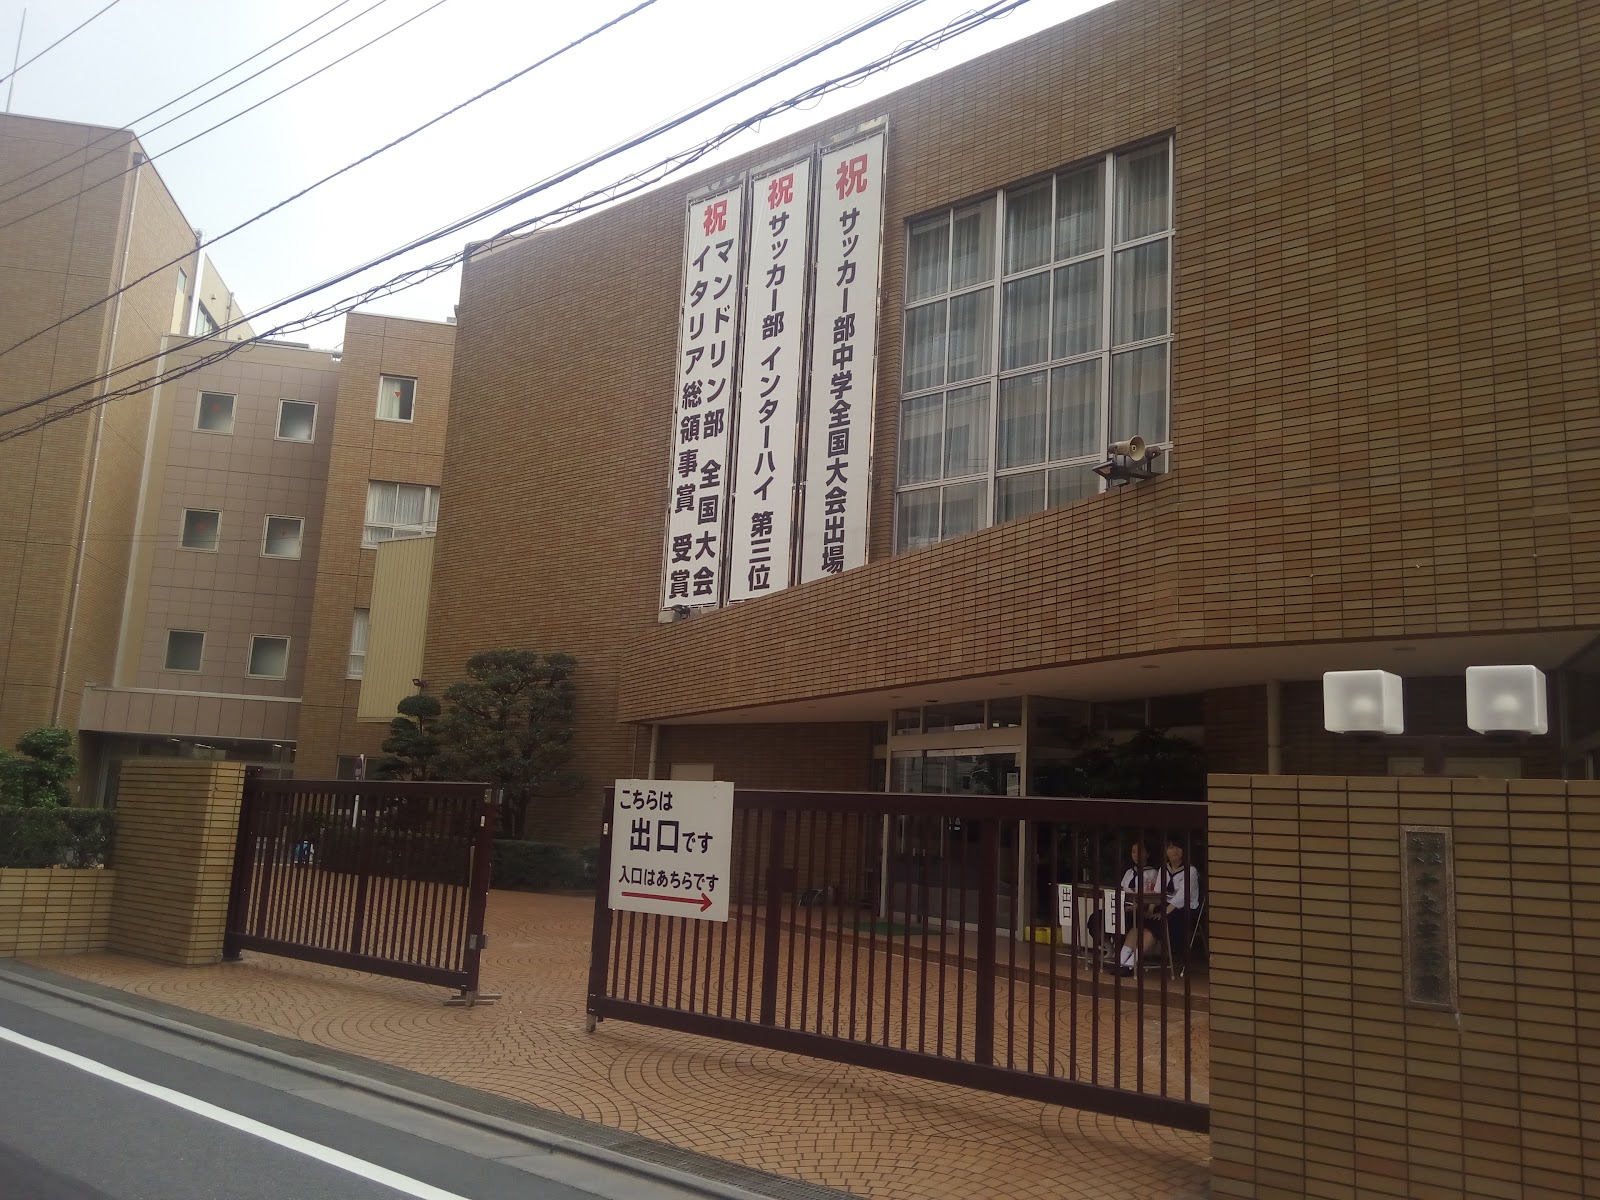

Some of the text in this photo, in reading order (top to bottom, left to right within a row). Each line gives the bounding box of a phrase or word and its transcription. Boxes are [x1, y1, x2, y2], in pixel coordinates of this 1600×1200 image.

[768, 172, 794, 210] 祝
[835, 153, 868, 200] 祝
[703, 199, 728, 237] 祝
[821, 207, 861, 574] サッカー部中学全国大会出場
[669, 245, 711, 599] イタリア総領事賞 受賞
[693, 238, 735, 596] マンドリン部 全国大会
[620, 789, 673, 811] こちらは
[629, 817, 714, 854] 出口です
[618, 865, 719, 892] 入口はあちらです
[1062, 886, 1072, 919] 出口
